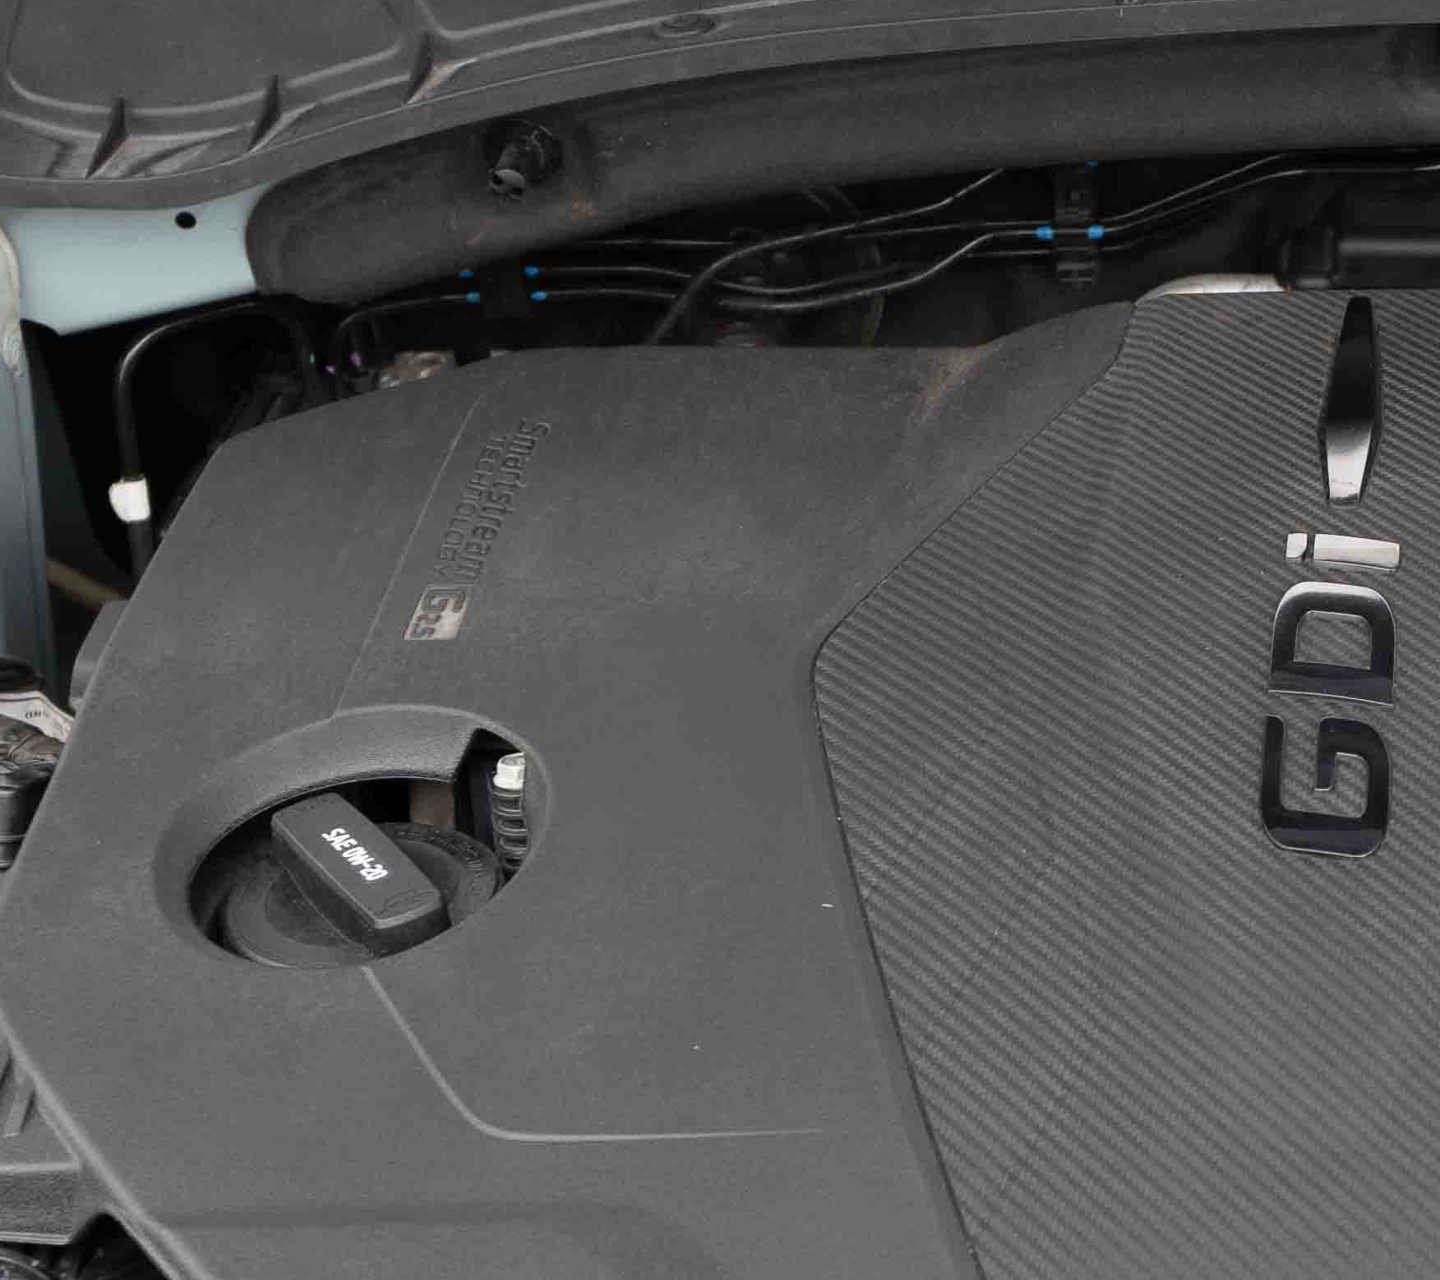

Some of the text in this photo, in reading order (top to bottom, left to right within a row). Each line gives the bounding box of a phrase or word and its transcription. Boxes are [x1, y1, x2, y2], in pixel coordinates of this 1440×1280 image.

[432, 435, 507, 577] TECHNOLOGY
[453, 417, 552, 586] Smartstream
[1262, 532, 1400, 858] GDi
[321, 827, 352, 852] SAE
[341, 846, 389, 881] 0W-20
